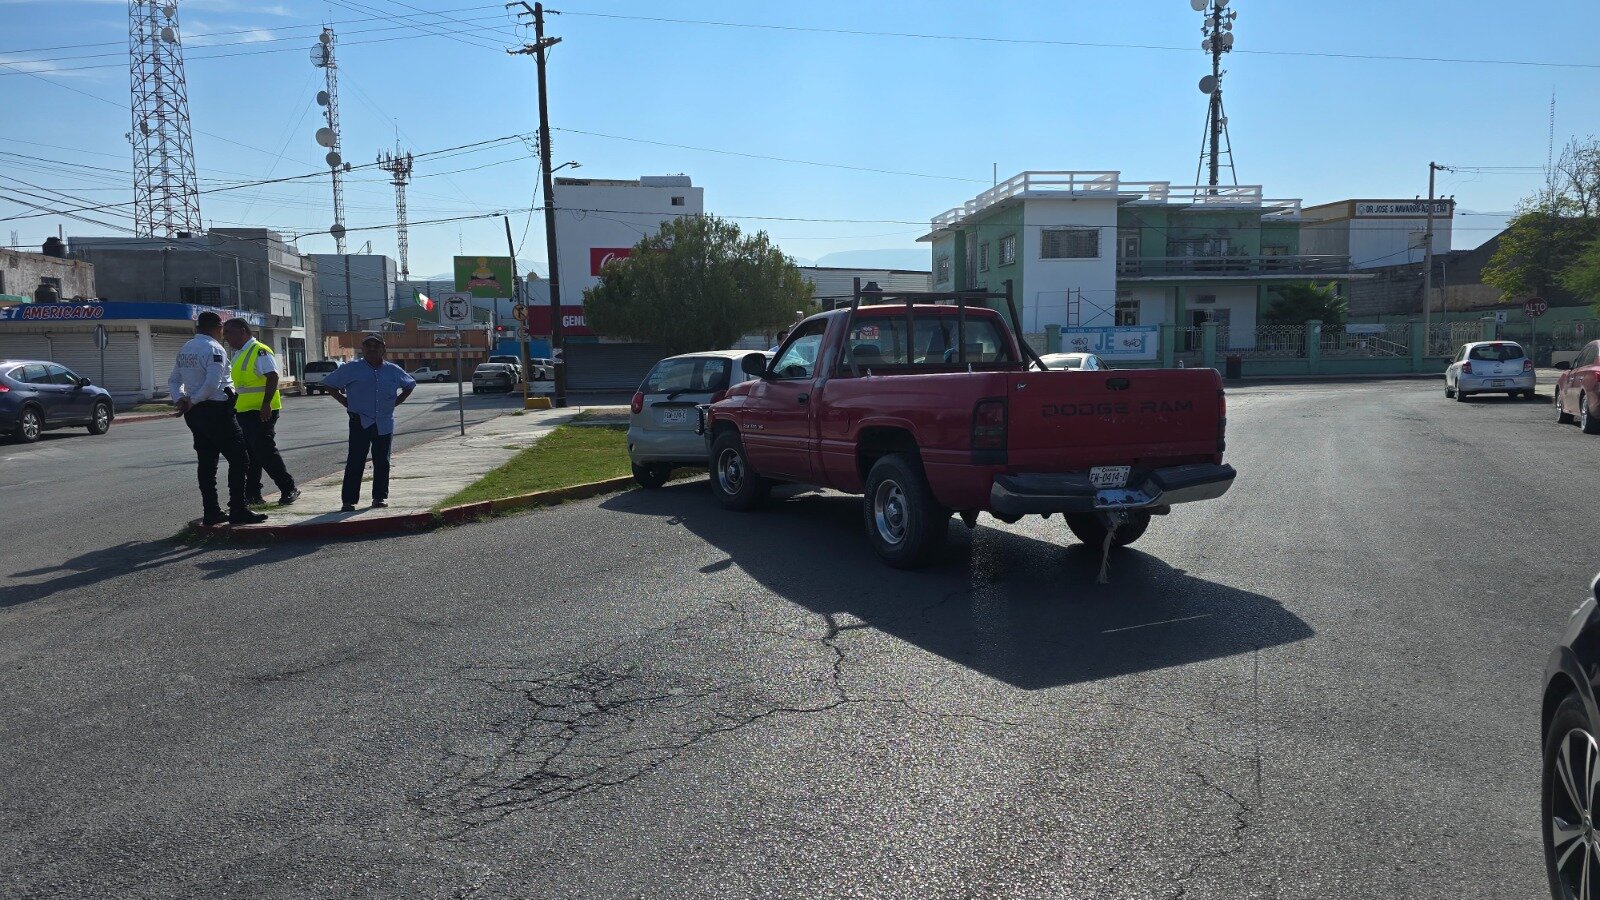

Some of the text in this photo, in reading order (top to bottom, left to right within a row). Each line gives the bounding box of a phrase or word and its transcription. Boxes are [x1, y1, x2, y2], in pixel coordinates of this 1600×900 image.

[1375, 205, 1388, 213] JOSE
[22, 305, 104, 319] AMERICANO
[1524, 302, 1546, 312] ALTO
[1042, 400, 1193, 417] DODGE RAM
